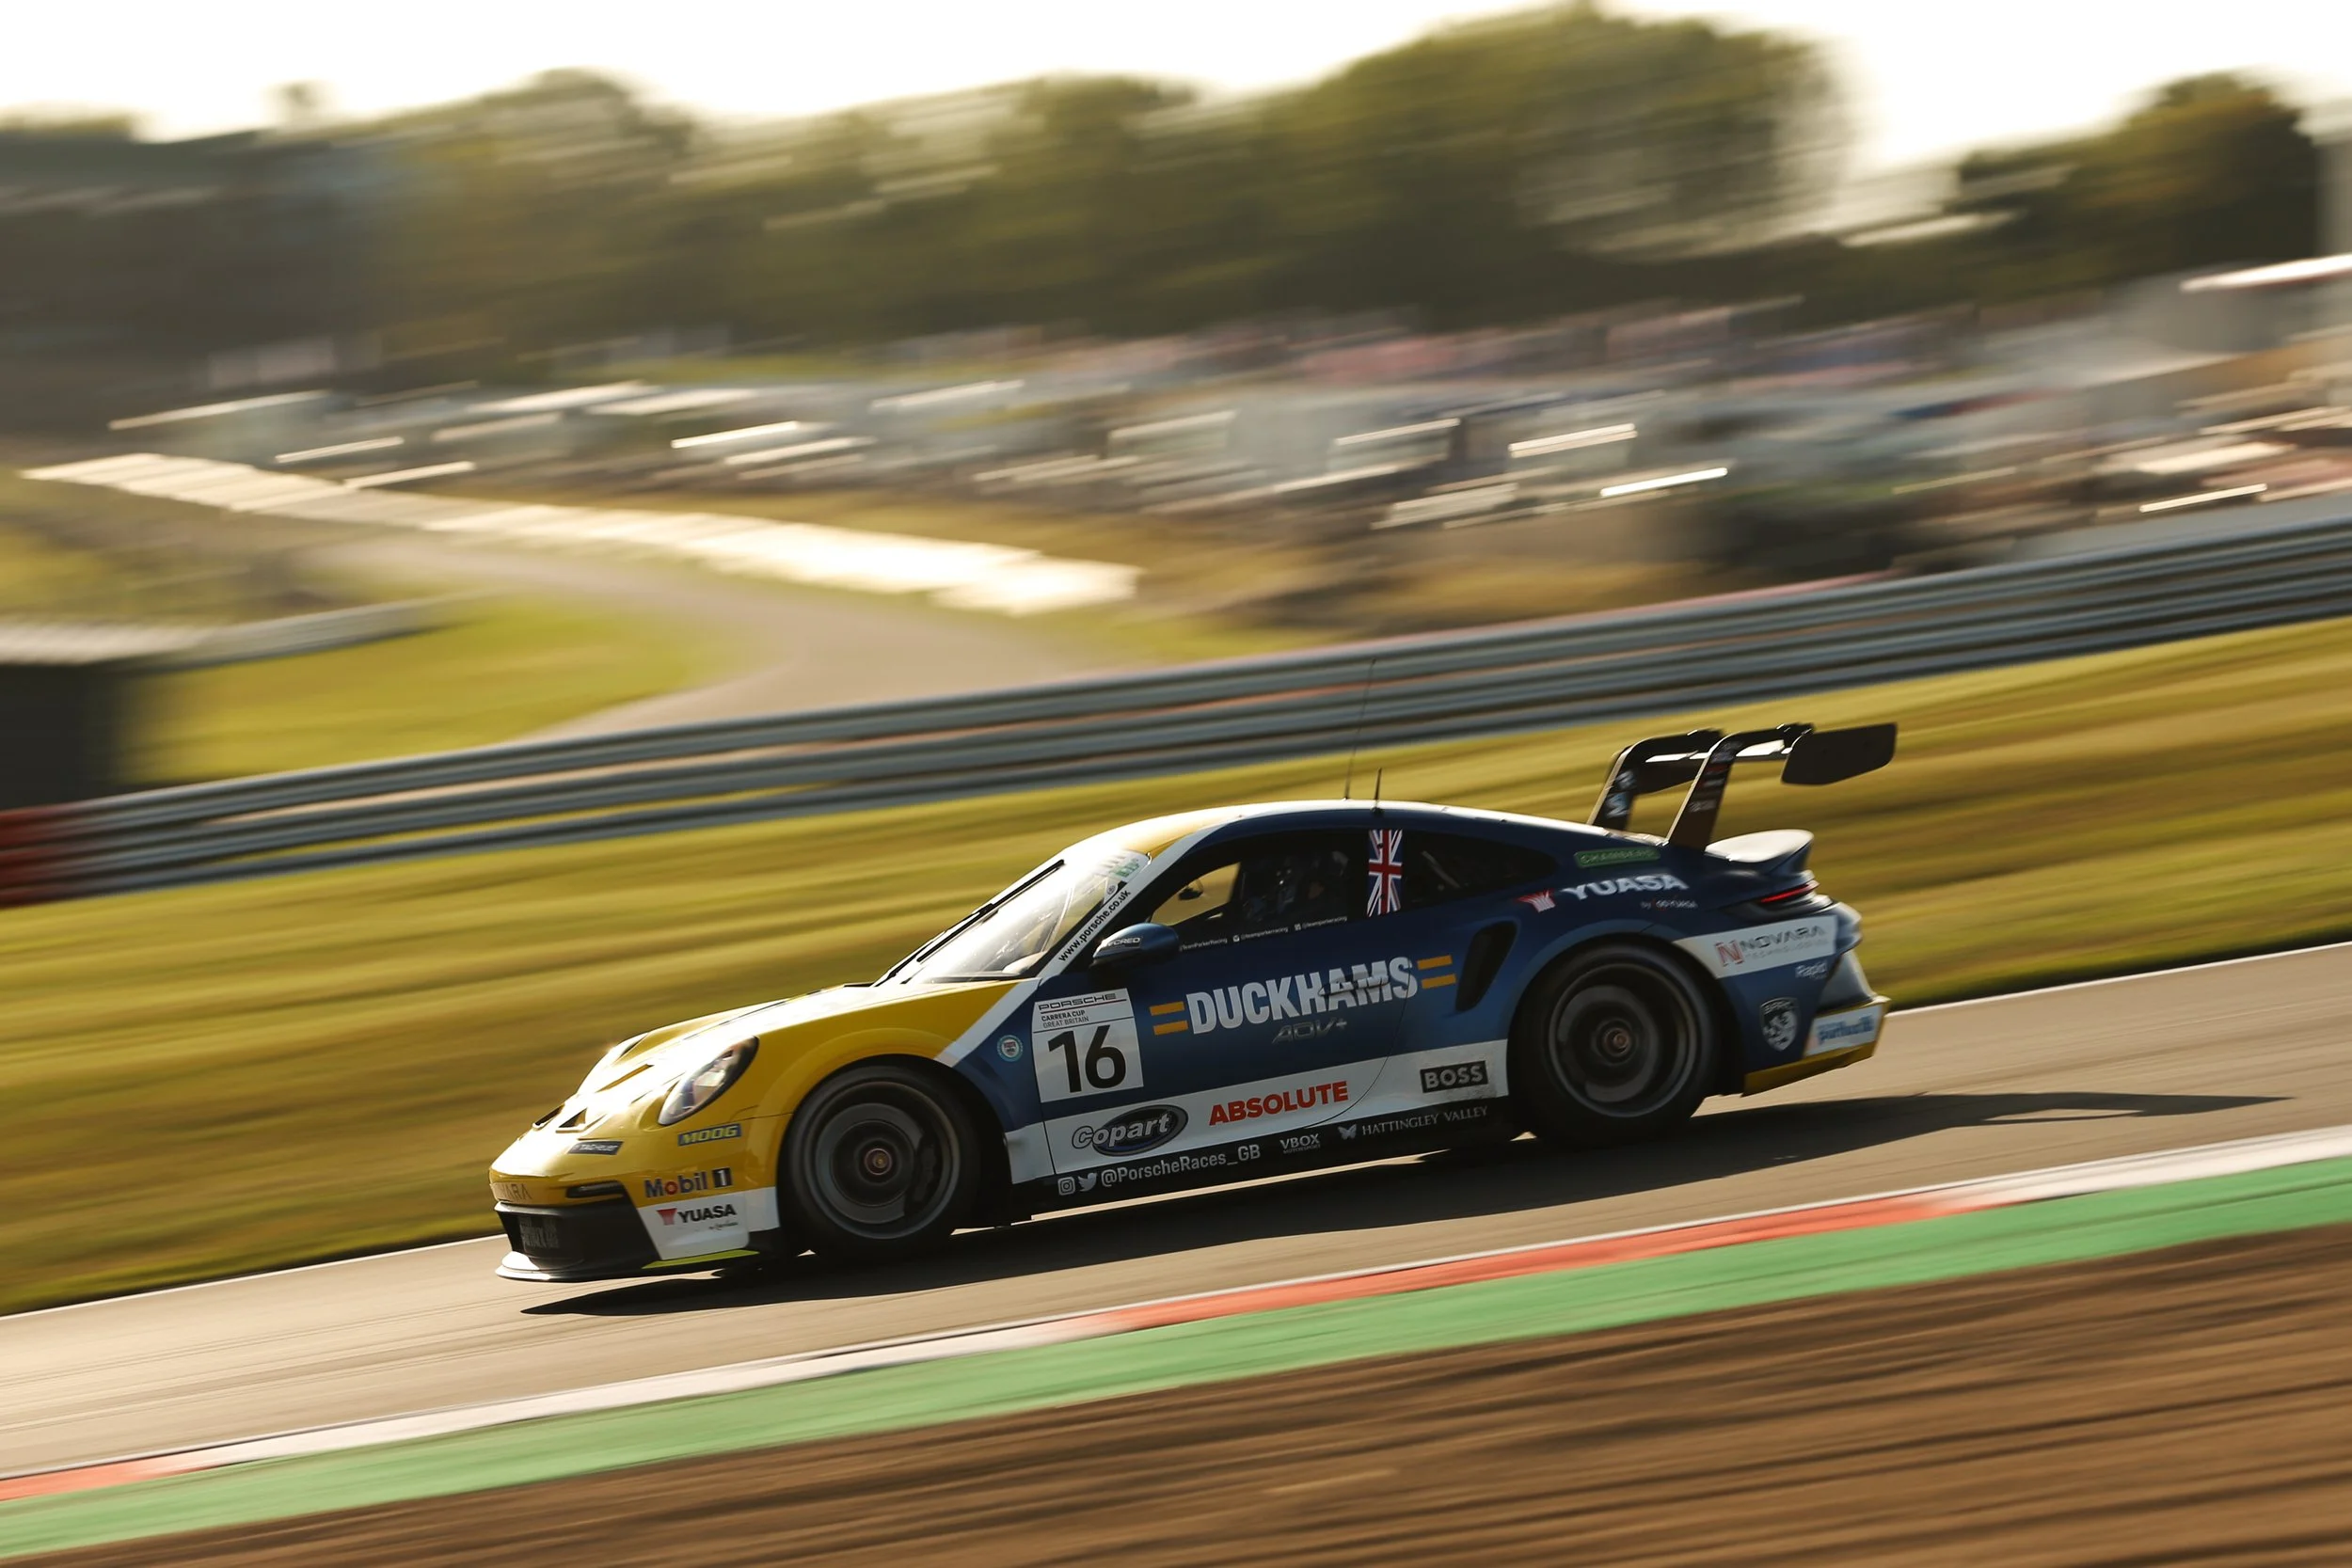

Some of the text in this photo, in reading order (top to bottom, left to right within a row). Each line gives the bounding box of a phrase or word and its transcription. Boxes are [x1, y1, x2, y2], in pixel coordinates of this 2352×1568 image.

[1561, 874, 1690, 900] YUASA
[1058, 890, 1132, 962] www.porsche.co.uk
[1740, 926, 1825, 949] NOVARA
[1038, 992, 1118, 1011] PORSCHE
[1185, 957, 1418, 1035] DUCKHAMS
[1041, 1009, 1086, 1022] CARRERA CUP
[1043, 1016, 1089, 1028] GREAT BRITAIN
[1047, 1024, 1127, 1093] 16
[1423, 1063, 1485, 1090] BOSS
[1209, 1081, 1349, 1126] ABSOLUTE
[682, 1125, 739, 1144] MOOG
[1073, 1114, 1170, 1149] Copart
[1361, 1106, 1488, 1136] HATTINGLEY VALLEY
[1279, 1133, 1320, 1149] VBOX
[1101, 1144, 1261, 1187] @PorscheRaces_GB
[644, 1169, 728, 1198] Mobil 1
[677, 1204, 738, 1224] YUASA
